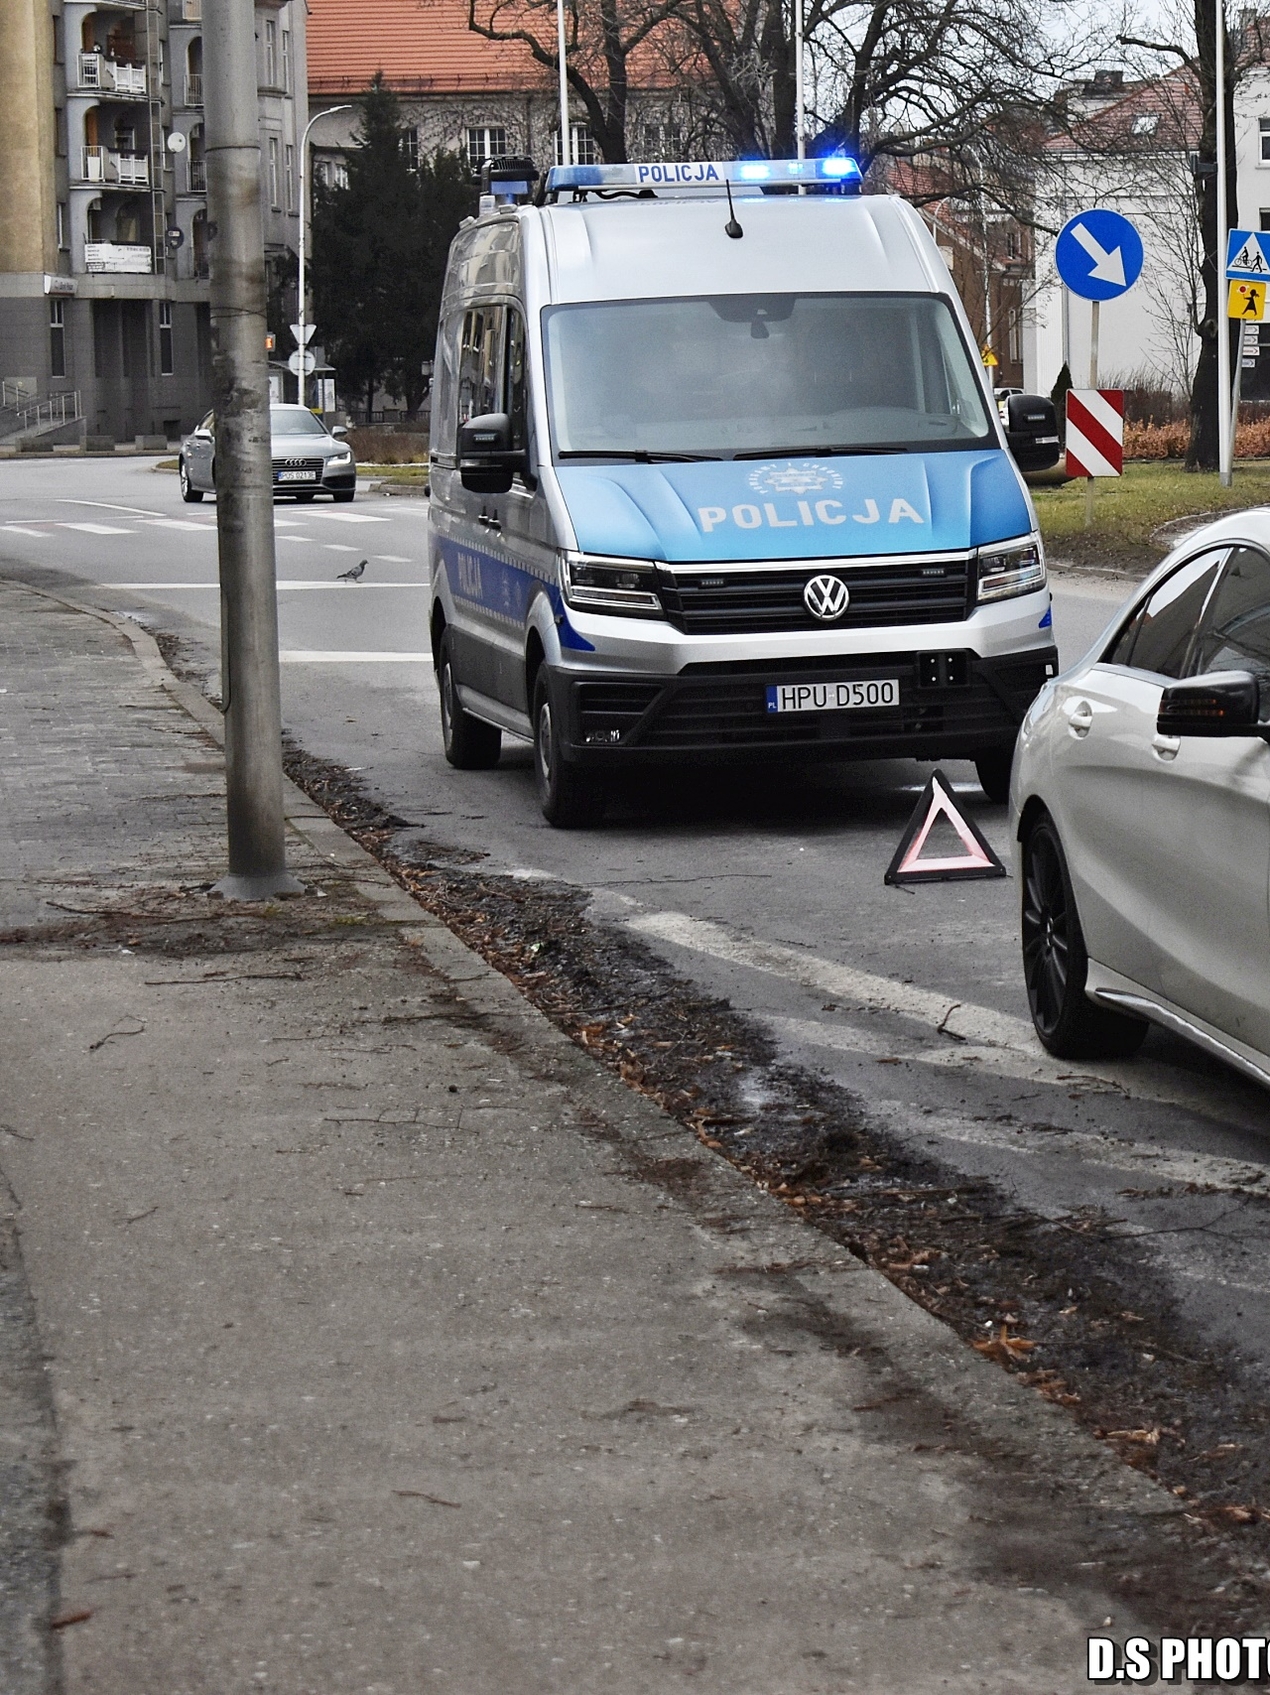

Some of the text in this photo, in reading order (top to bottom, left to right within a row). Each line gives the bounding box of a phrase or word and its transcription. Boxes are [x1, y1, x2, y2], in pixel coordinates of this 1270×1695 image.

[638, 164, 719, 183] POLICJA
[698, 498, 924, 532] POLICJA
[781, 682, 894, 709] HPU D500
